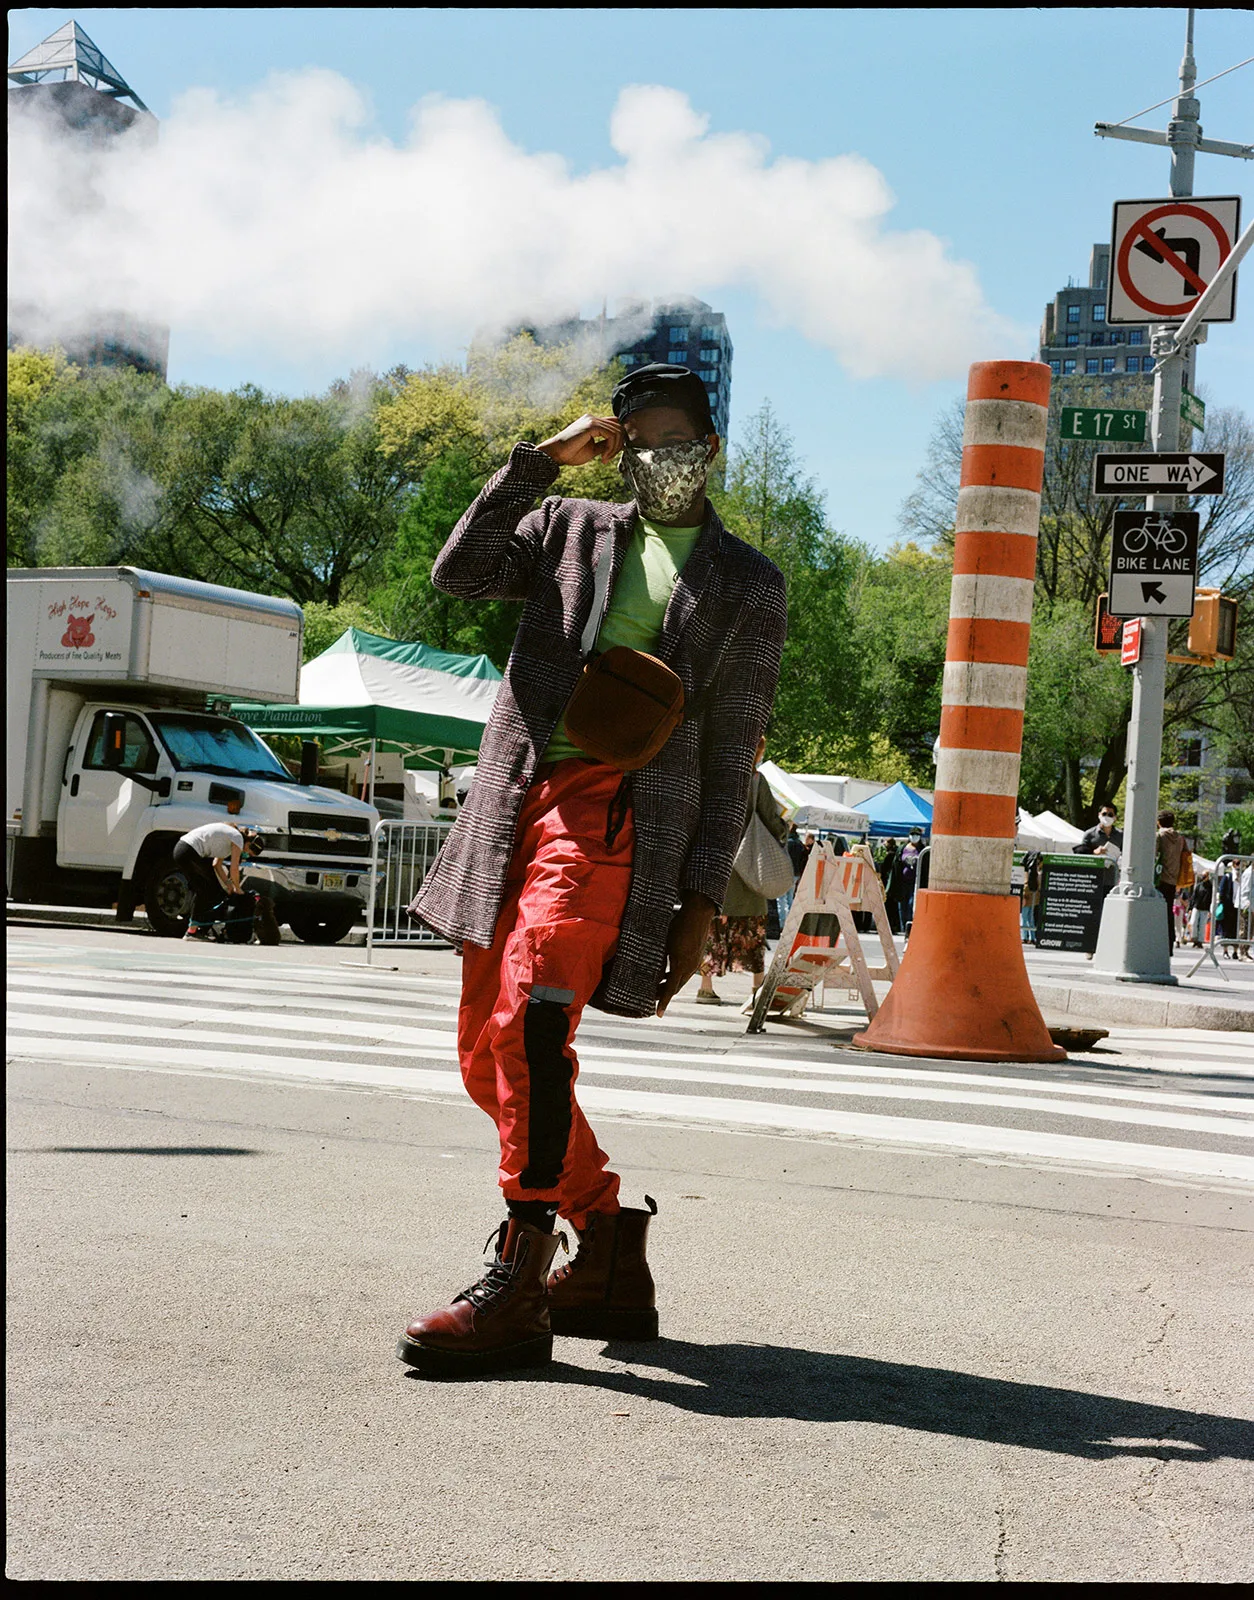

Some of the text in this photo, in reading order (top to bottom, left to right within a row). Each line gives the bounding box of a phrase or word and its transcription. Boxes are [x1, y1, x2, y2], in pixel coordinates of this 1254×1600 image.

[1073, 412, 1137, 437] E 17 St
[1114, 466, 1205, 482] ONE WAY
[1117, 557, 1191, 571] BIKE LANE
[48, 600, 67, 619] High
[40, 650, 64, 660] Producers
[65, 652, 71, 660] of
[83, 651, 103, 662] Quality
[105, 651, 121, 660] Meats
[261, 709, 323, 722] Plantation
[1040, 939, 1062, 947] GROW
